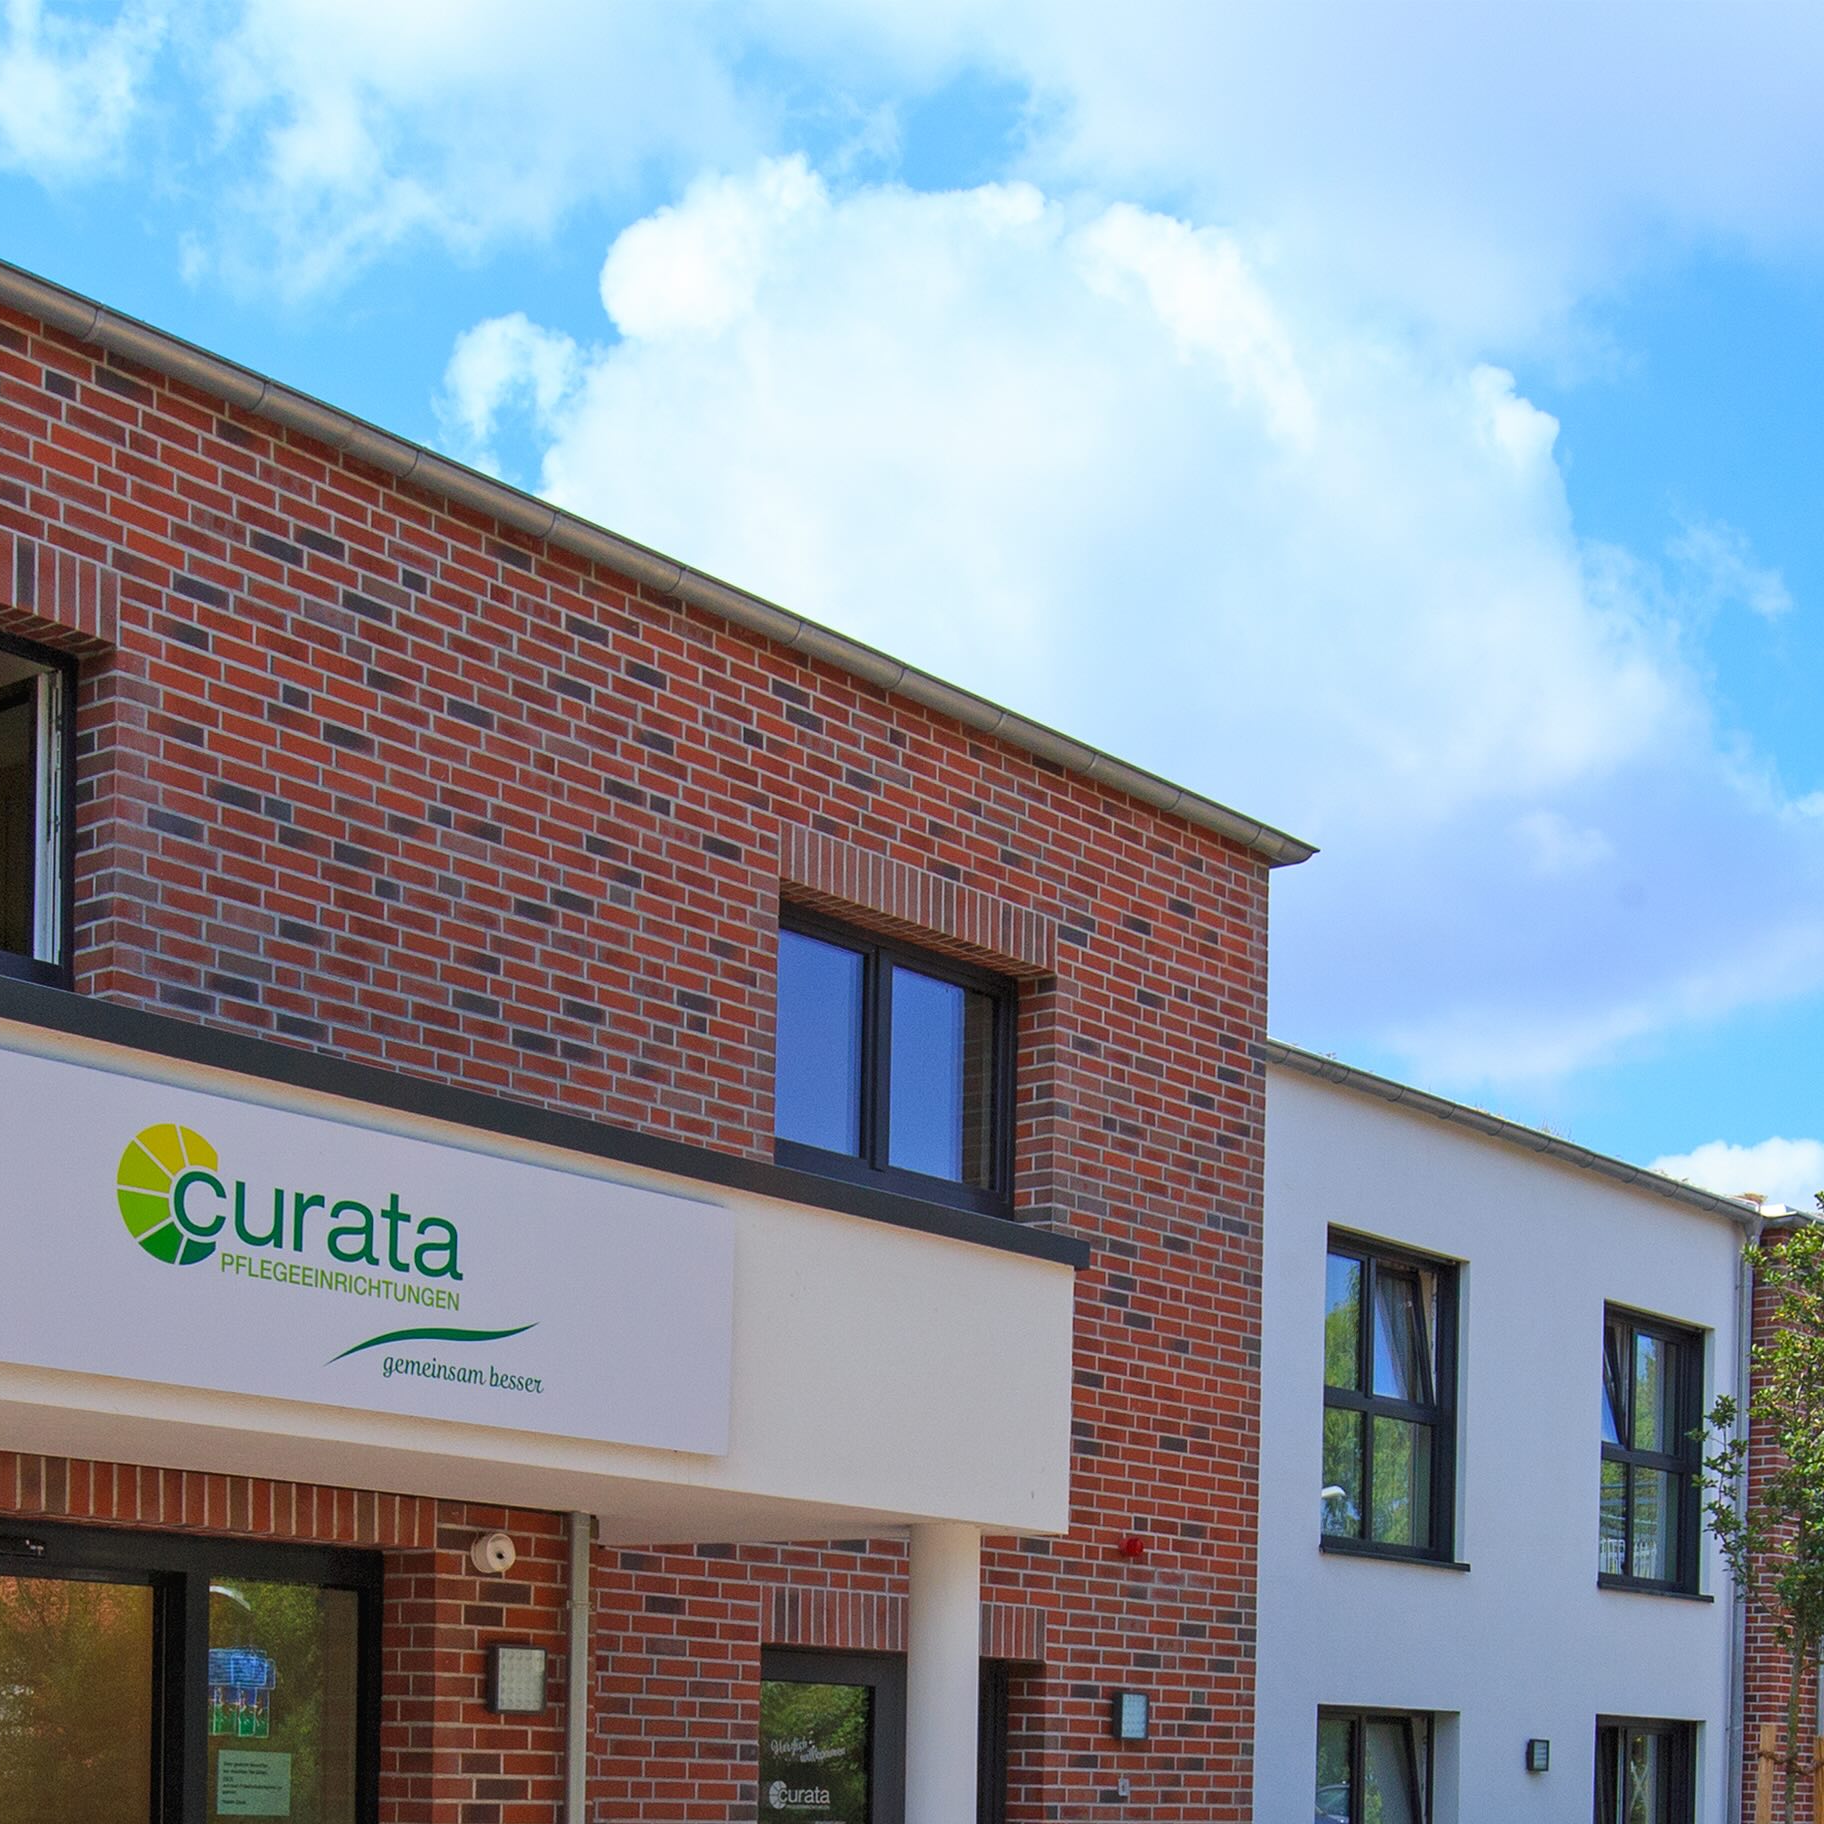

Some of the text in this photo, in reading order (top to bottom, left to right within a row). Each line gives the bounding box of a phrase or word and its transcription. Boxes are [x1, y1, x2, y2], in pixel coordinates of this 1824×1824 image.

[174, 1170, 464, 1281] curata
[220, 1252, 461, 1311] PFLEGEEINRICHTUNGEN
[382, 1354, 545, 1394] gemeinsam besser
[778, 1785, 831, 1804] curata
